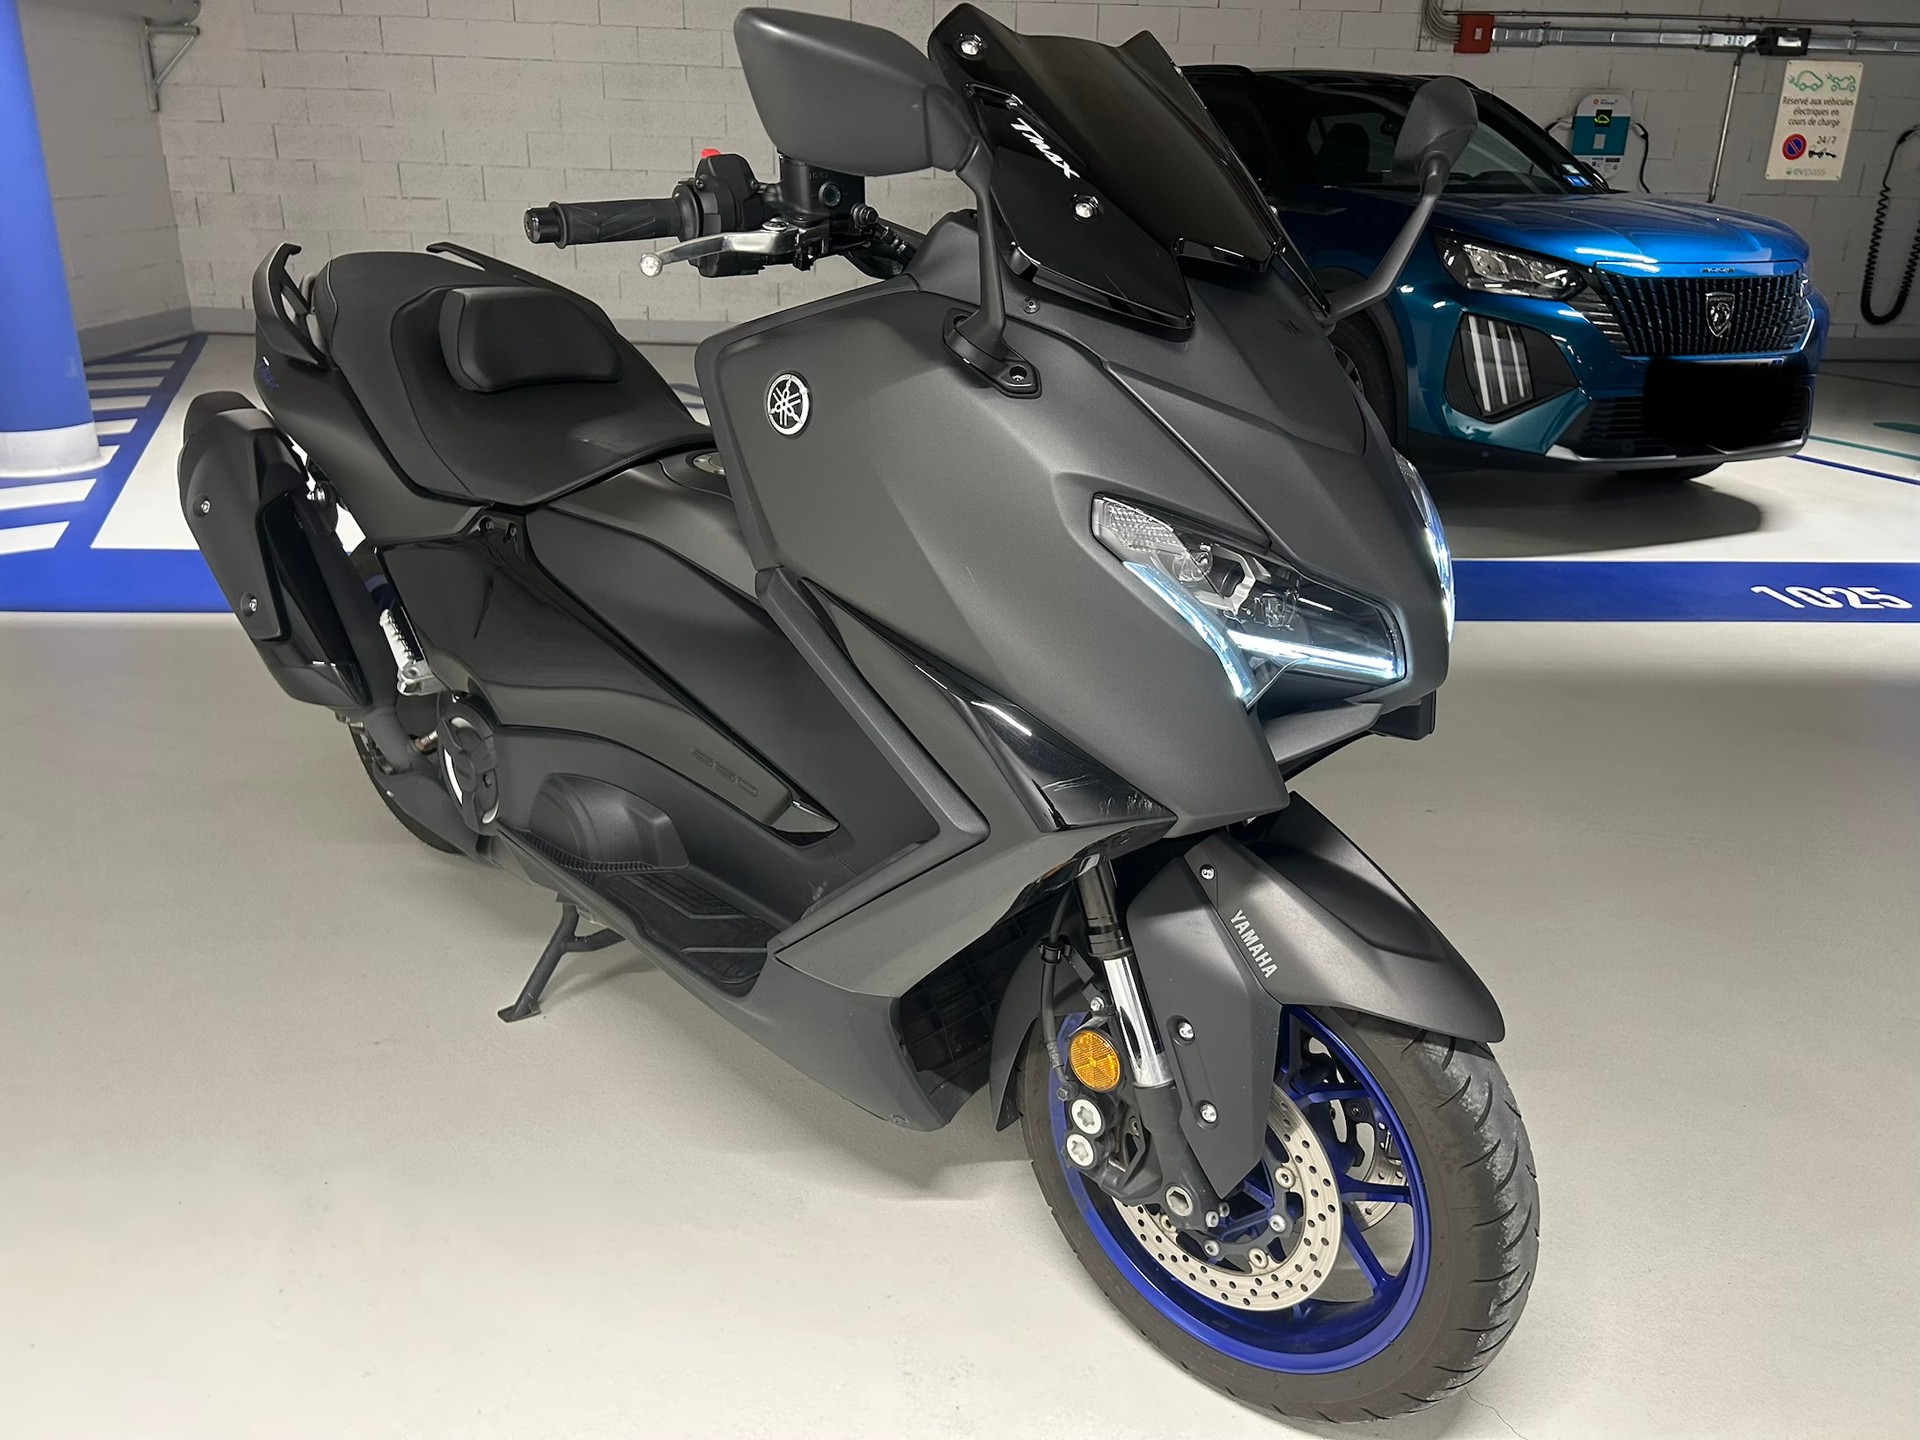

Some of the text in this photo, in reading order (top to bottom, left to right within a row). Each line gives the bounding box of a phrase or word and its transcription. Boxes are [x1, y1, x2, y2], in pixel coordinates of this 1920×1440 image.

[1810, 98, 1822, 106] aux
[1808, 118, 1816, 126] de
[1818, 118, 1841, 128] charge
[1010, 117, 1081, 179] TMAX
[1750, 585, 1913, 609] 1025
[1230, 909, 1278, 978] YAMAHA
